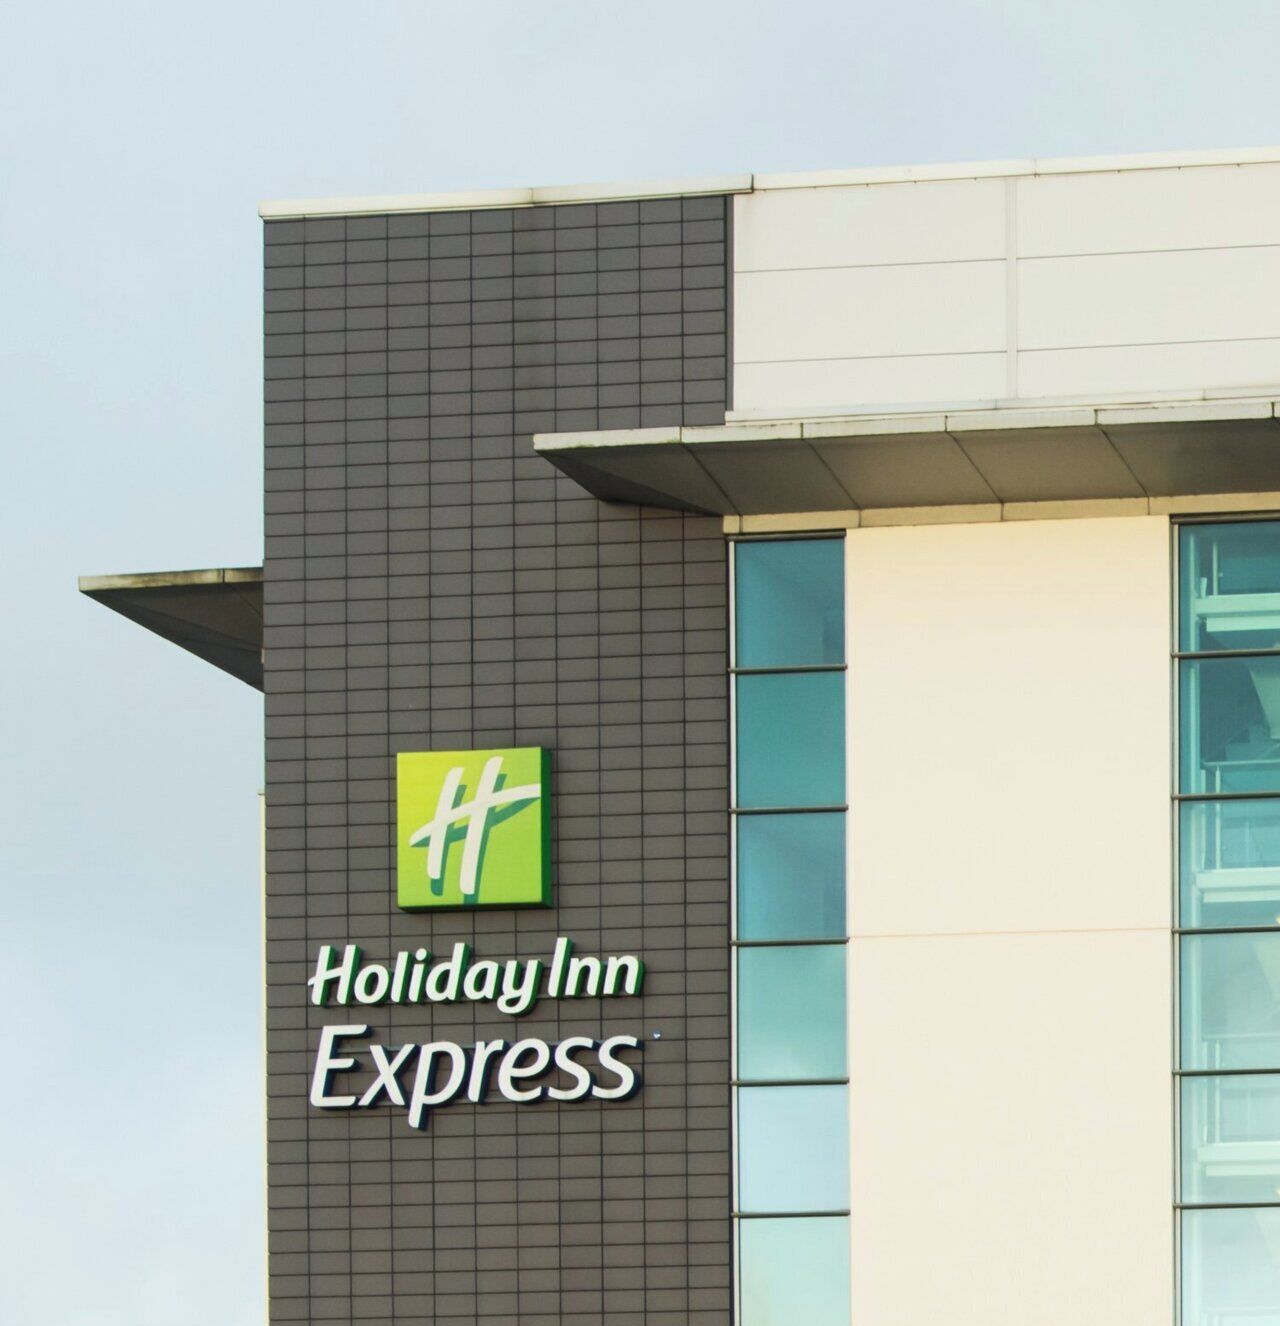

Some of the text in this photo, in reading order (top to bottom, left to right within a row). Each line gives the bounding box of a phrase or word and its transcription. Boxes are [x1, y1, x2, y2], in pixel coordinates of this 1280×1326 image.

[308, 937, 643, 1016] Holiday Inn
[310, 1024, 641, 1129] Express
